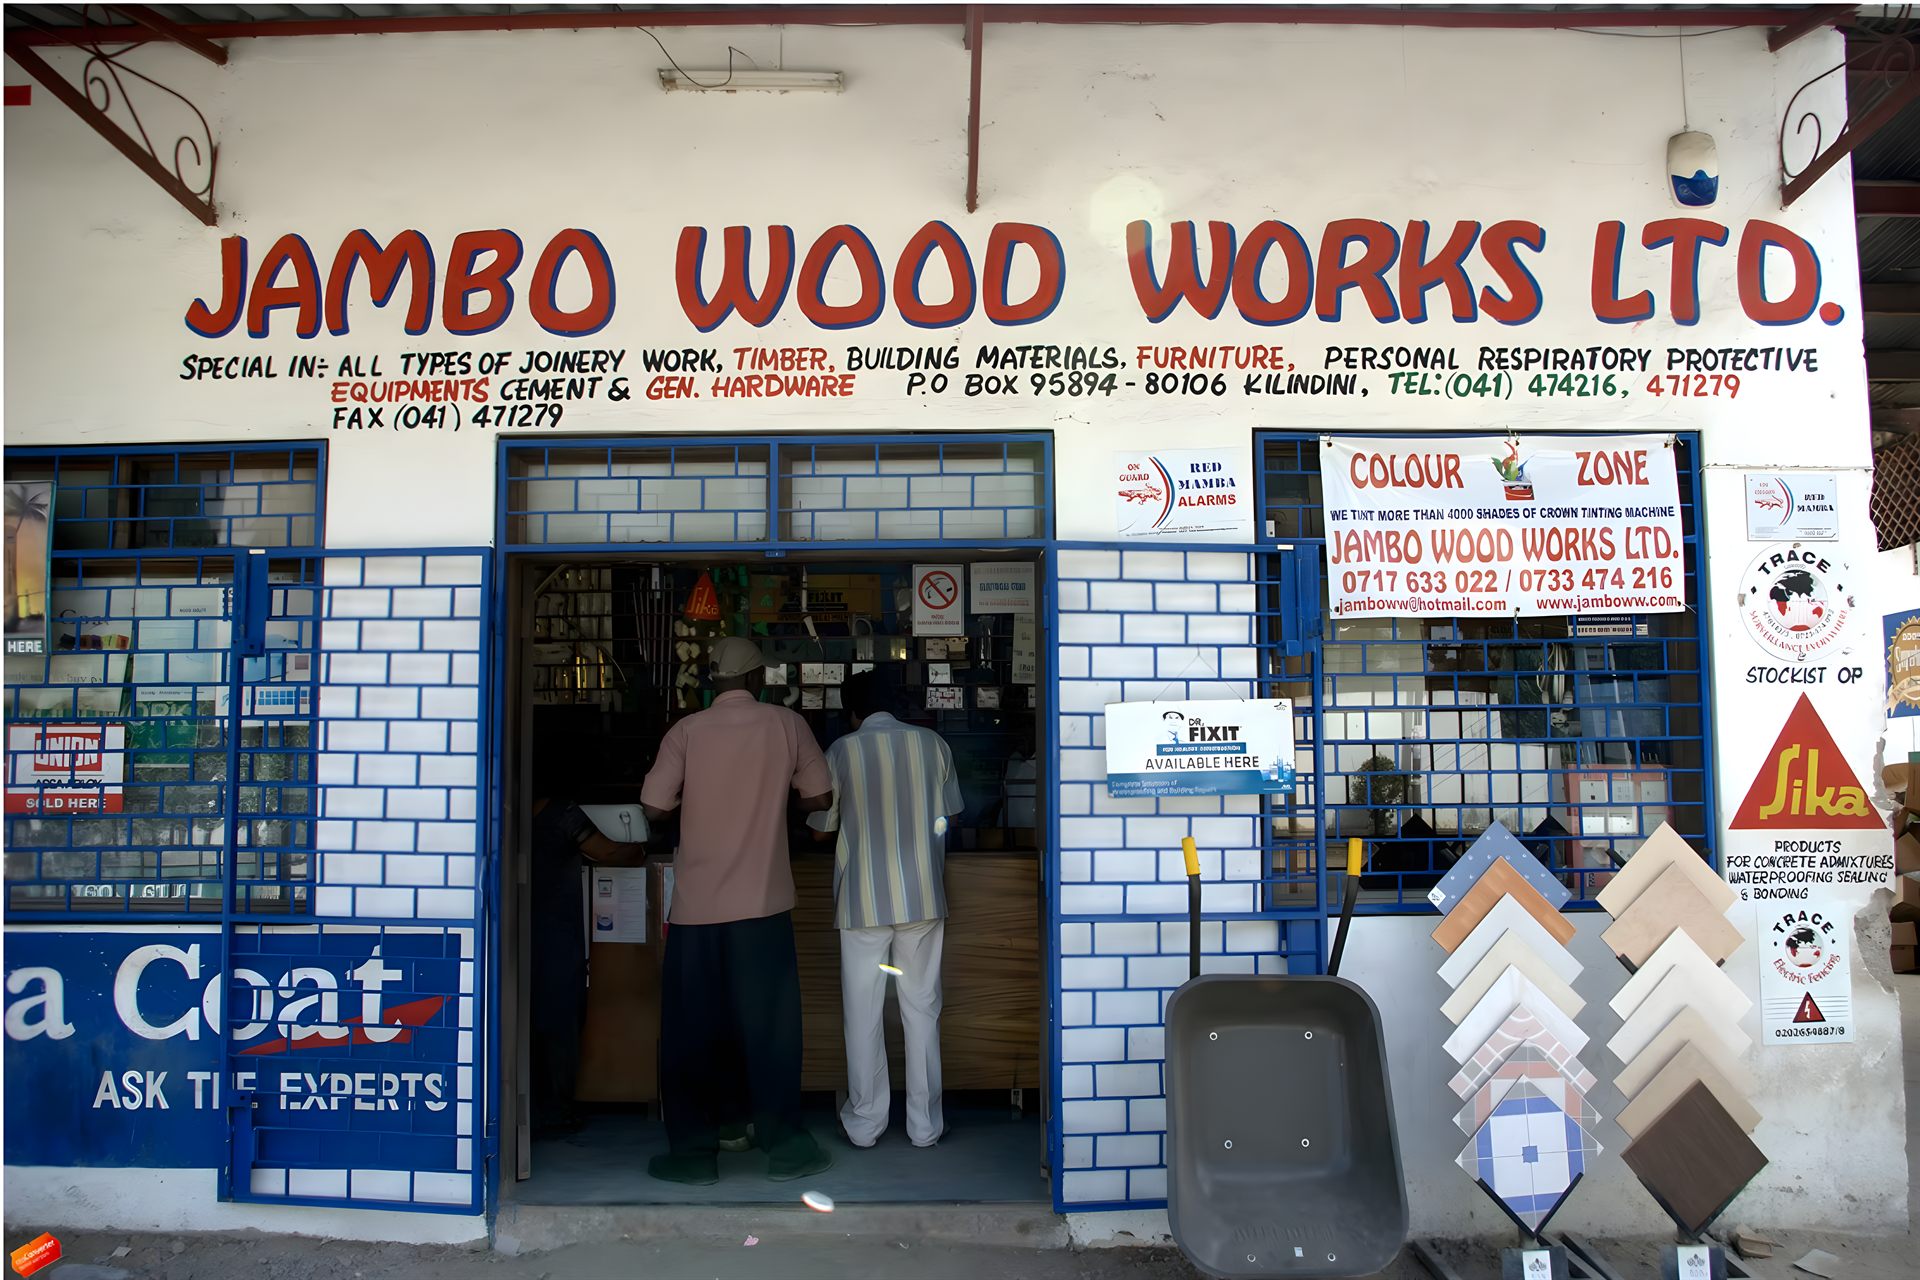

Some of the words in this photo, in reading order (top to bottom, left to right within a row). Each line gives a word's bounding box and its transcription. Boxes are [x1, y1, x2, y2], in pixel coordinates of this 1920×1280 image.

[184, 229, 616, 339] JAMBO
[675, 220, 1066, 333] WOOD
[1126, 219, 1546, 325] WORKS
[1591, 218, 1845, 326] LTD.
[180, 354, 277, 380] SPECIAL
[338, 355, 383, 377] ALL
[400, 350, 472, 376] TYPES
[478, 350, 512, 375] OF
[519, 349, 626, 374] JOINERY
[643, 349, 723, 375] WORK,
[733, 347, 836, 374] TIMBER,
[847, 345, 960, 371] BUILDING
[976, 345, 1126, 370] MATERIALS,
[1137, 346, 1296, 371] FURNITURE,
[1325, 346, 1460, 371] PERSONAL
[1478, 347, 1652, 372] RESPIRATORY
[1667, 348, 1818, 371] PROTECTIVE
[331, 377, 490, 403] EQUIPMENTS
[500, 378, 602, 401] CEMENT
[608, 380, 631, 401] &
[646, 376, 699, 399] GEN.
[712, 374, 855, 397] HARDWARE
[965, 374, 1018, 396] BOX
[1244, 374, 1369, 398] KILINDINI,
[1528, 373, 1629, 398] 474216,
[1647, 373, 1741, 398] 471279
[333, 406, 384, 429] FAX
[472, 404, 564, 430] 471279
[1190, 462, 1222, 473] RED
[1350, 452, 1464, 488] COLOUR
[1575, 450, 1649, 486] ZONE
[1178, 477, 1236, 490] MAMBA
[1178, 494, 1237, 507] ALARMS
[1330, 509, 1348, 521] WE
[1350, 509, 1374, 521] TINT
[1378, 509, 1410, 521] MORE
[1413, 508, 1444, 520] THAN
[1447, 508, 1474, 520] 4000
[1476, 508, 1520, 520] SHADES
[1522, 507, 1537, 519] OF
[1540, 507, 1578, 519] CROWN
[1581, 507, 1622, 518] TINTING
[1625, 506, 1675, 518] MACHINE
[1331, 529, 1422, 564] JAMBO
[1431, 527, 1513, 563] WOOD
[1522, 526, 1615, 562] WORKS
[1625, 525, 1679, 560] LTD.
[1757, 550, 1831, 576] TRACE
[1342, 569, 1397, 593] 0717
[1406, 569, 1447, 593] 633
[1455, 569, 1498, 593] 022
[1505, 569, 1512, 592] /
[1519, 568, 1575, 592] 0733
[1582, 568, 1625, 591] 474
[1632, 566, 1673, 589] 216
[1339, 597, 1506, 613] jamboww@hotmail.com
[1536, 594, 1679, 612] www.jamboww.com
[8, 640, 43, 653] HERE
[1746, 667, 1827, 684] STOCKIST
[1189, 726, 1240, 742] FIXIT
[35, 736, 100, 768] UNION
[1145, 757, 1220, 770] AVAILABLE
[1224, 756, 1260, 768] HERE
[1759, 743, 1870, 820] Sika
[26, 798, 64, 809] SOLD
[1774, 841, 1841, 853] PRODUCTS
[1727, 856, 1751, 868] FOR
[1754, 855, 1816, 868] CONCRETE
[1728, 871, 1833, 884] WATERPROOFING
[1837, 871, 1888, 883] SEALING
[1753, 888, 1809, 899] BONDING
[1773, 910, 1834, 935] TRACE
[1773, 958, 1806, 985] Electric
[113, 943, 402, 1043] Coat
[93, 1070, 169, 1110] ASK
[280, 1072, 448, 1111] EXPERTS
